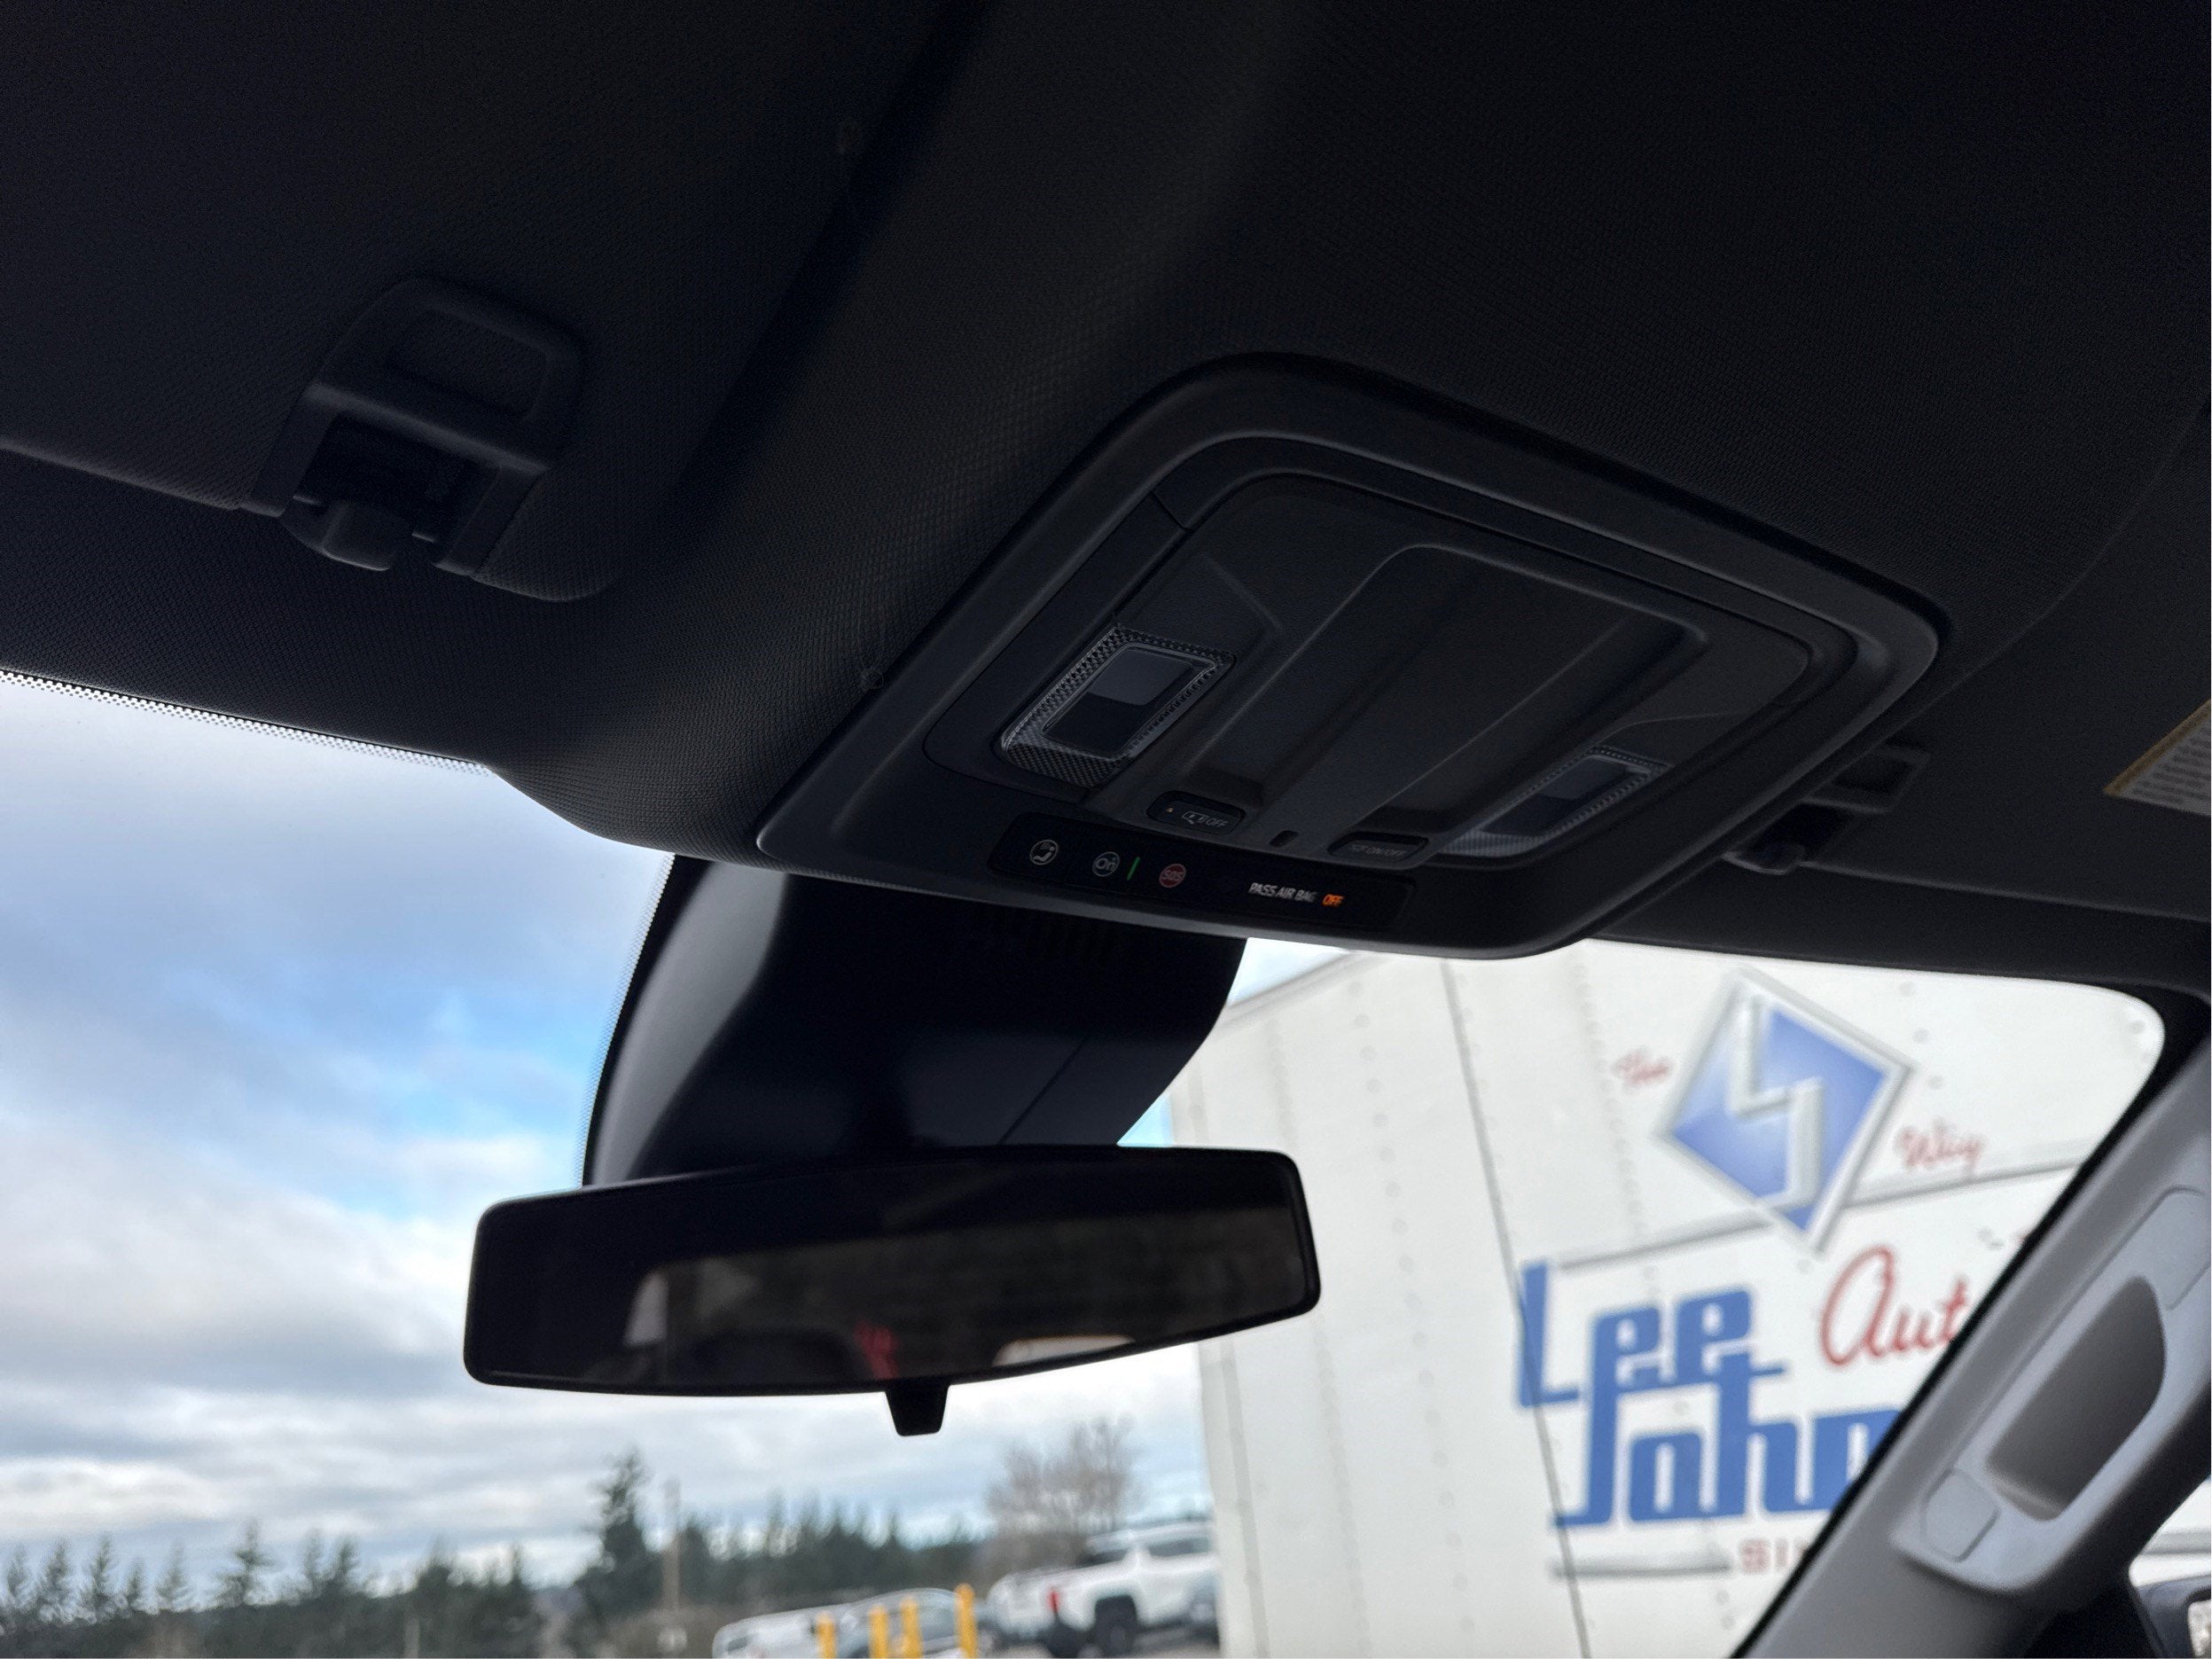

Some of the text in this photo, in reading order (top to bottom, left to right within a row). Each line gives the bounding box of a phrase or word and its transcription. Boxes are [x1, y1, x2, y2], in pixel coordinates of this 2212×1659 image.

[1206, 817, 1230, 828] OFF
[1161, 868, 1184, 881] SOS
[1248, 882, 1347, 908] PASS AIR BAG OFF
[1820, 1243, 1970, 1366] Aut
[1519, 1261, 1784, 1408] Lee
